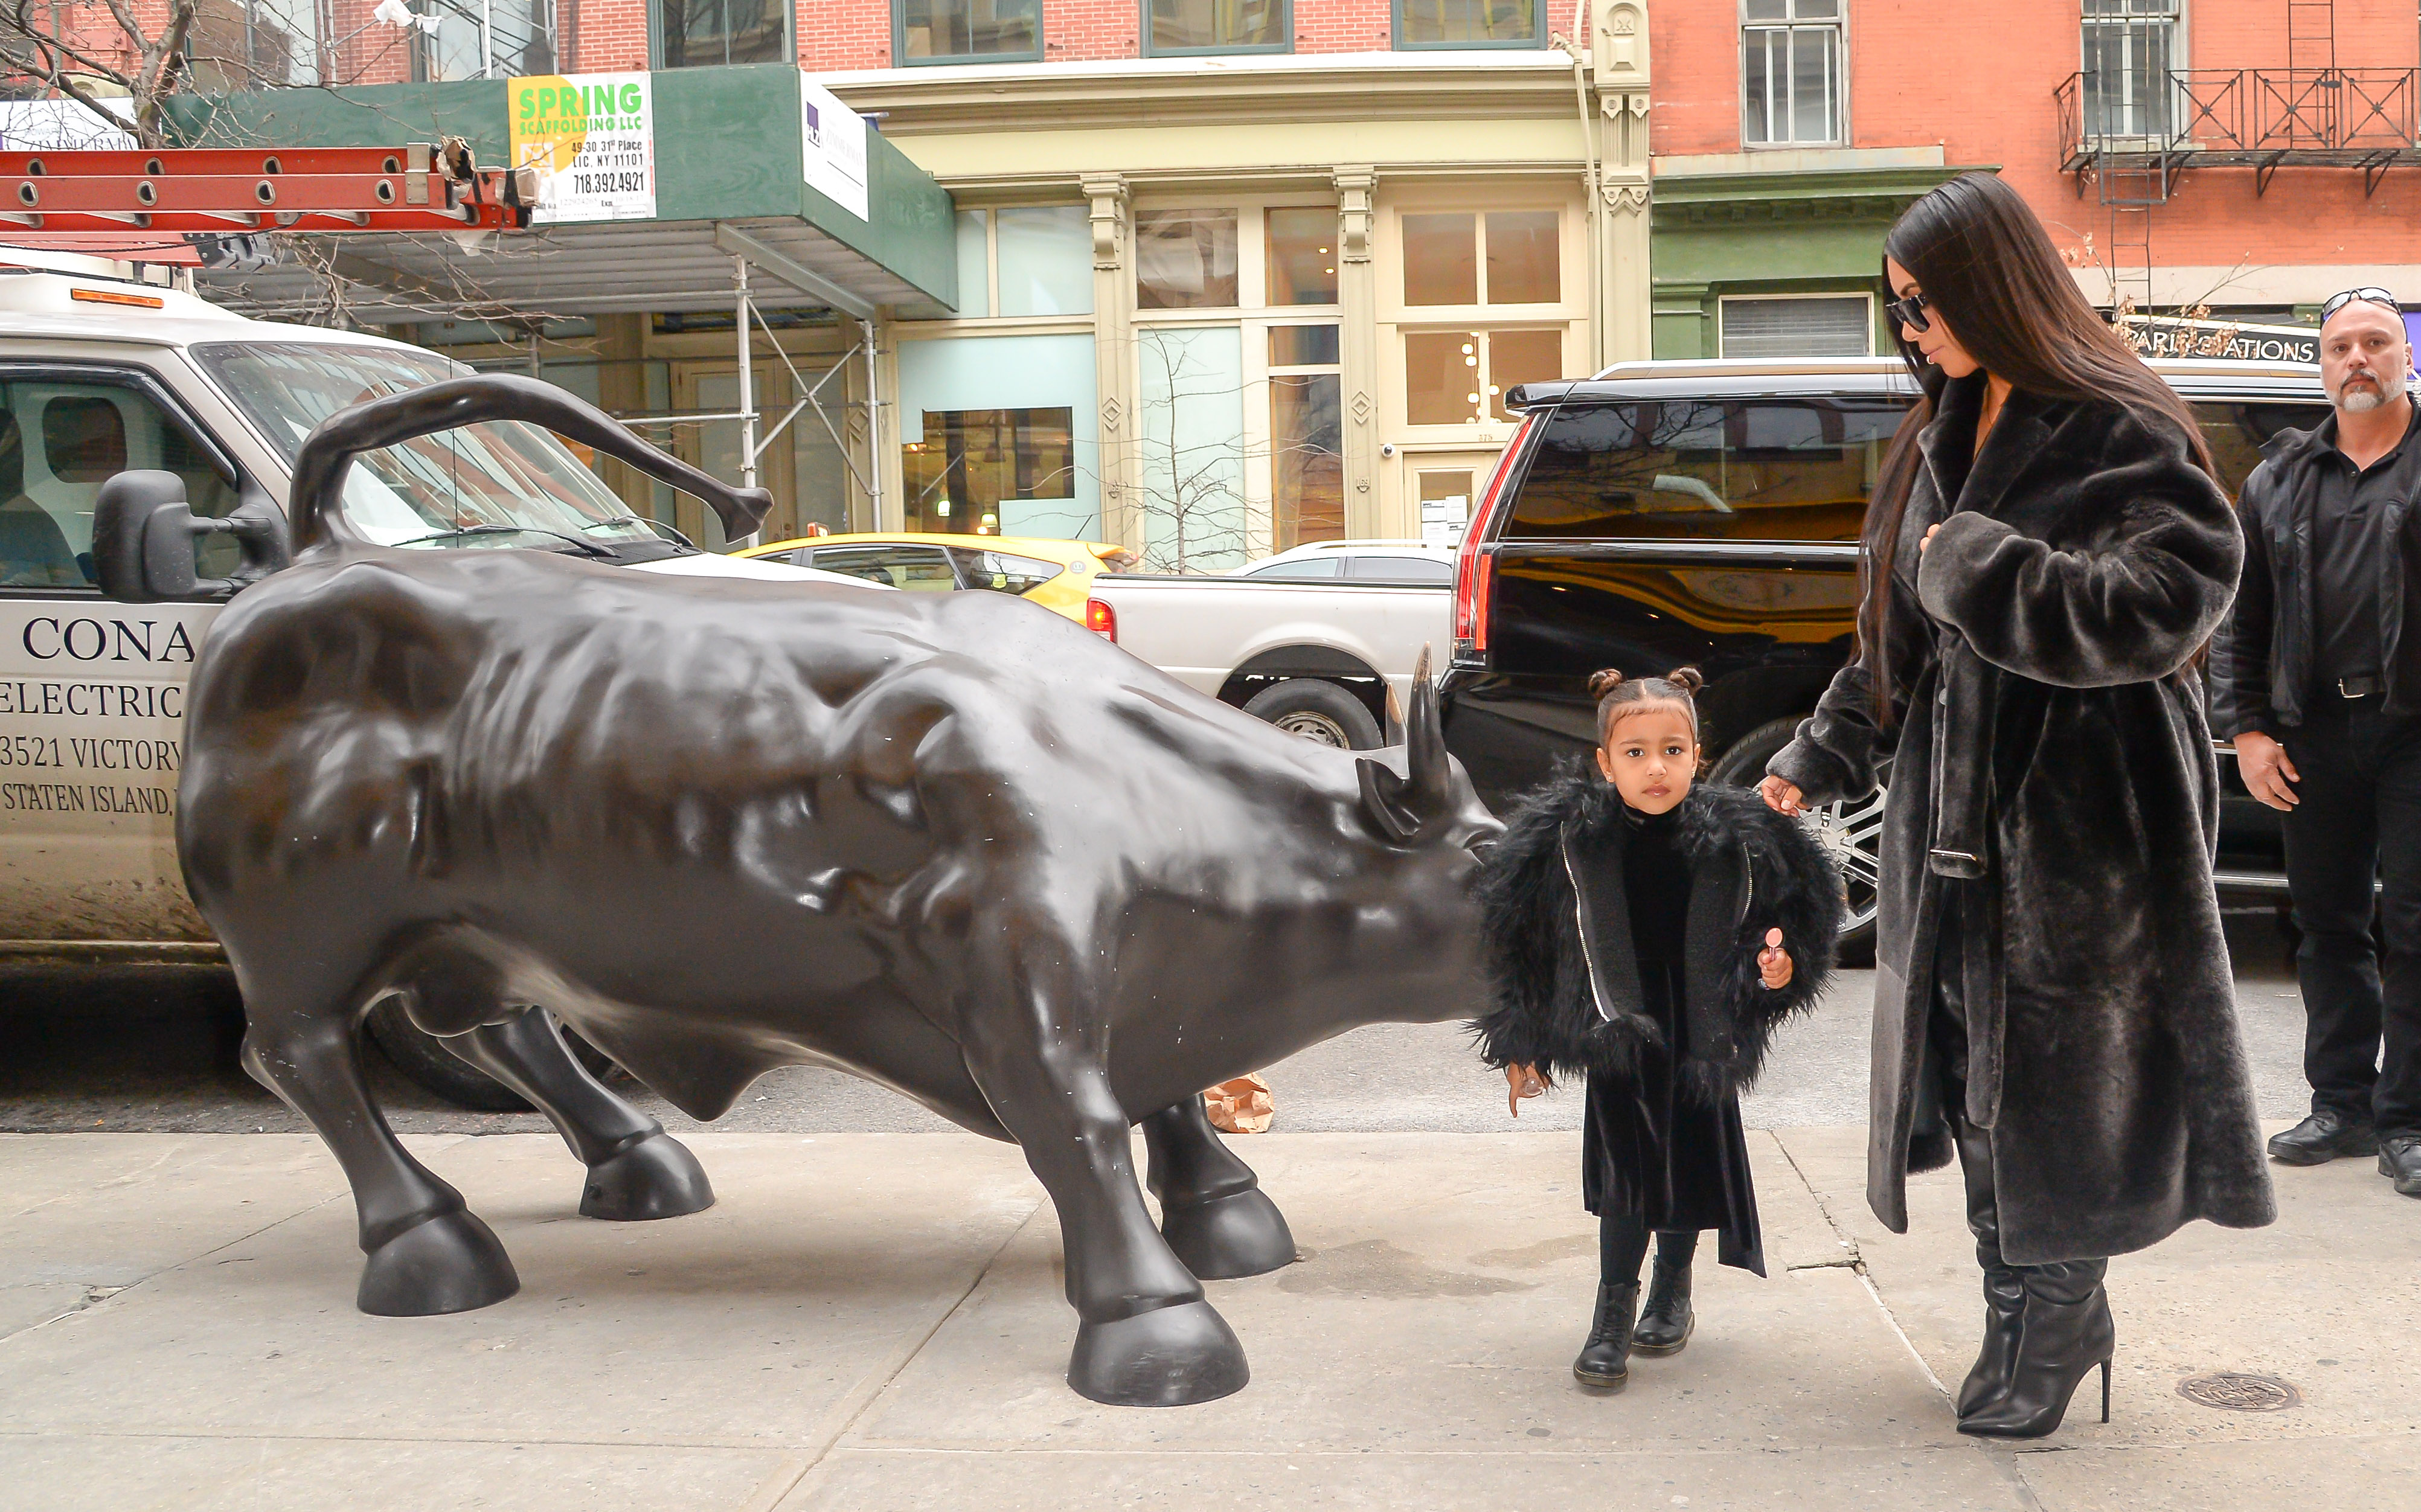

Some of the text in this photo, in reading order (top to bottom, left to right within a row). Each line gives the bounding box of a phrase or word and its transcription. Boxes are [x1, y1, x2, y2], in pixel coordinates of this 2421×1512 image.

[519, 83, 641, 119] SPRING
[620, 116, 642, 130] LLC
[571, 141, 597, 153] 49-30
[618, 140, 642, 151] Place
[597, 154, 609, 167] NY
[614, 153, 643, 166] 11101
[574, 171, 644, 194] 718.392.4921
[22, 617, 196, 662] CONA
[0, 682, 182, 718] ELECTRIC
[0, 735, 64, 767] 3521
[3, 783, 85, 812] STATEN
